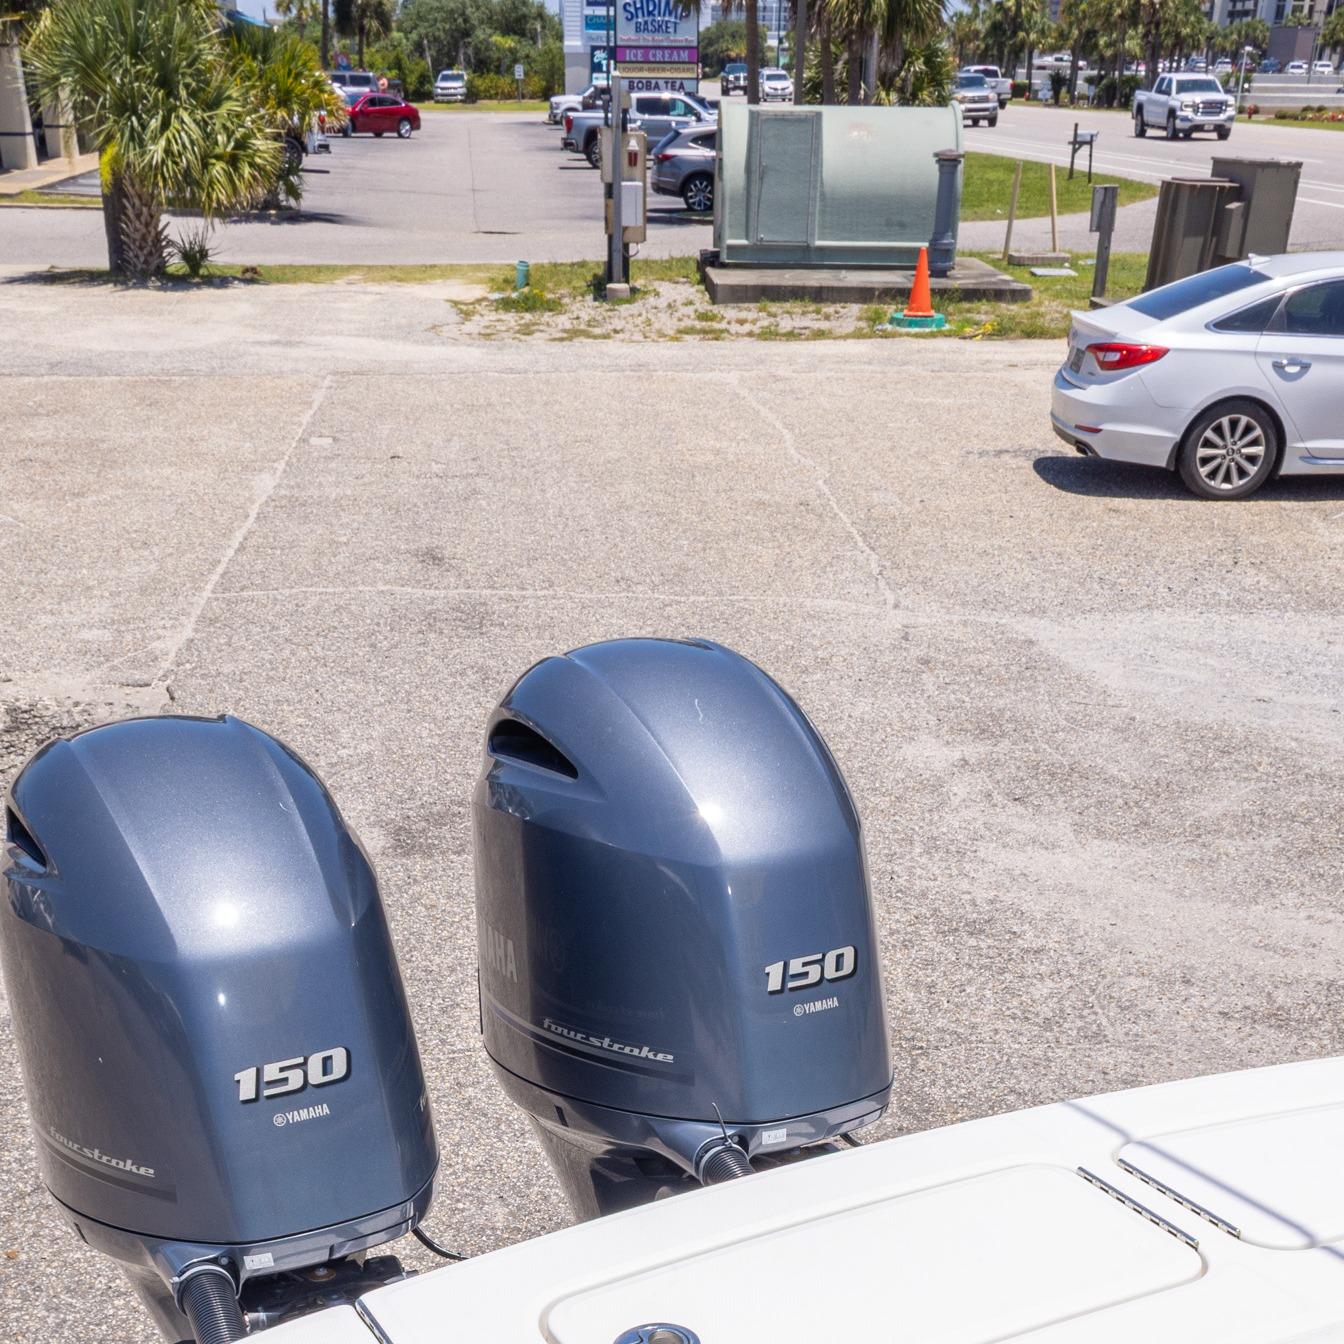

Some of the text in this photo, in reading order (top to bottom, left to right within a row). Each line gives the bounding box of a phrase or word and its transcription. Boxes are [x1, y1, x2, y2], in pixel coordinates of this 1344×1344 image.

[635, 20, 679, 34] BASKET
[626, 49, 688, 61] ICE CREAM
[628, 80, 685, 91] BOBA TEA
[764, 945, 856, 993] 150
[803, 996, 839, 1014] YAMAHA
[234, 1046, 349, 1102] 150
[285, 1103, 331, 1123] YAMAHA
